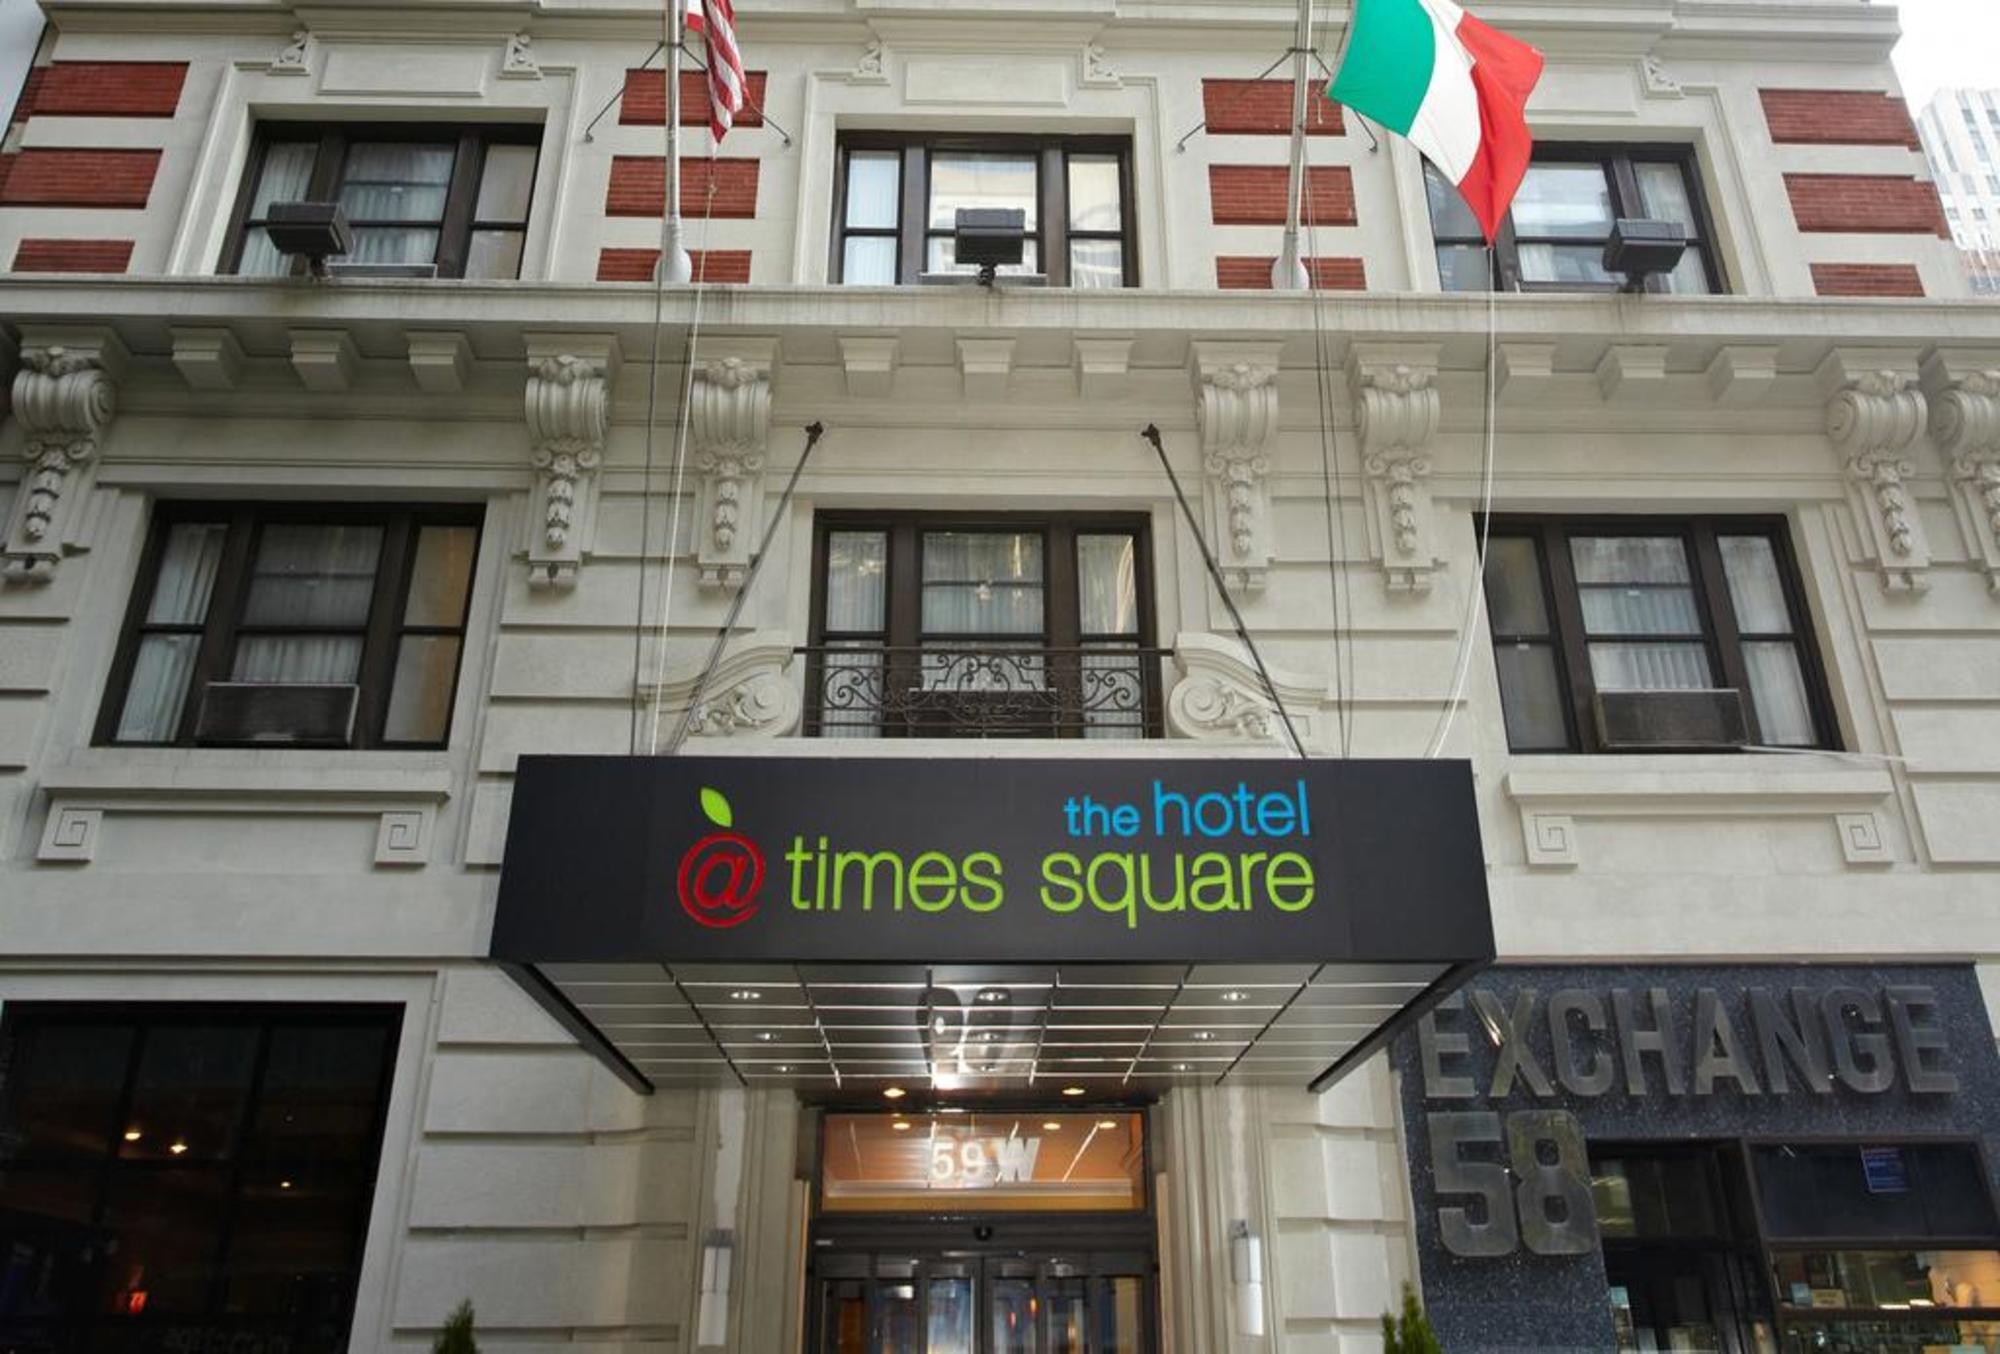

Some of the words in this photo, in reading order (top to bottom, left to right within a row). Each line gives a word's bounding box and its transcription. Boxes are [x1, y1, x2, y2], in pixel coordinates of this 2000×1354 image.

[1063, 795, 1142, 837] the
[1152, 779, 1310, 837] hotel
[677, 832, 766, 929] @
[785, 836, 1004, 912] times
[1039, 851, 1315, 928] square
[1417, 984, 1959, 1099] EXCHANGE
[1427, 1109, 1598, 1258] 58
